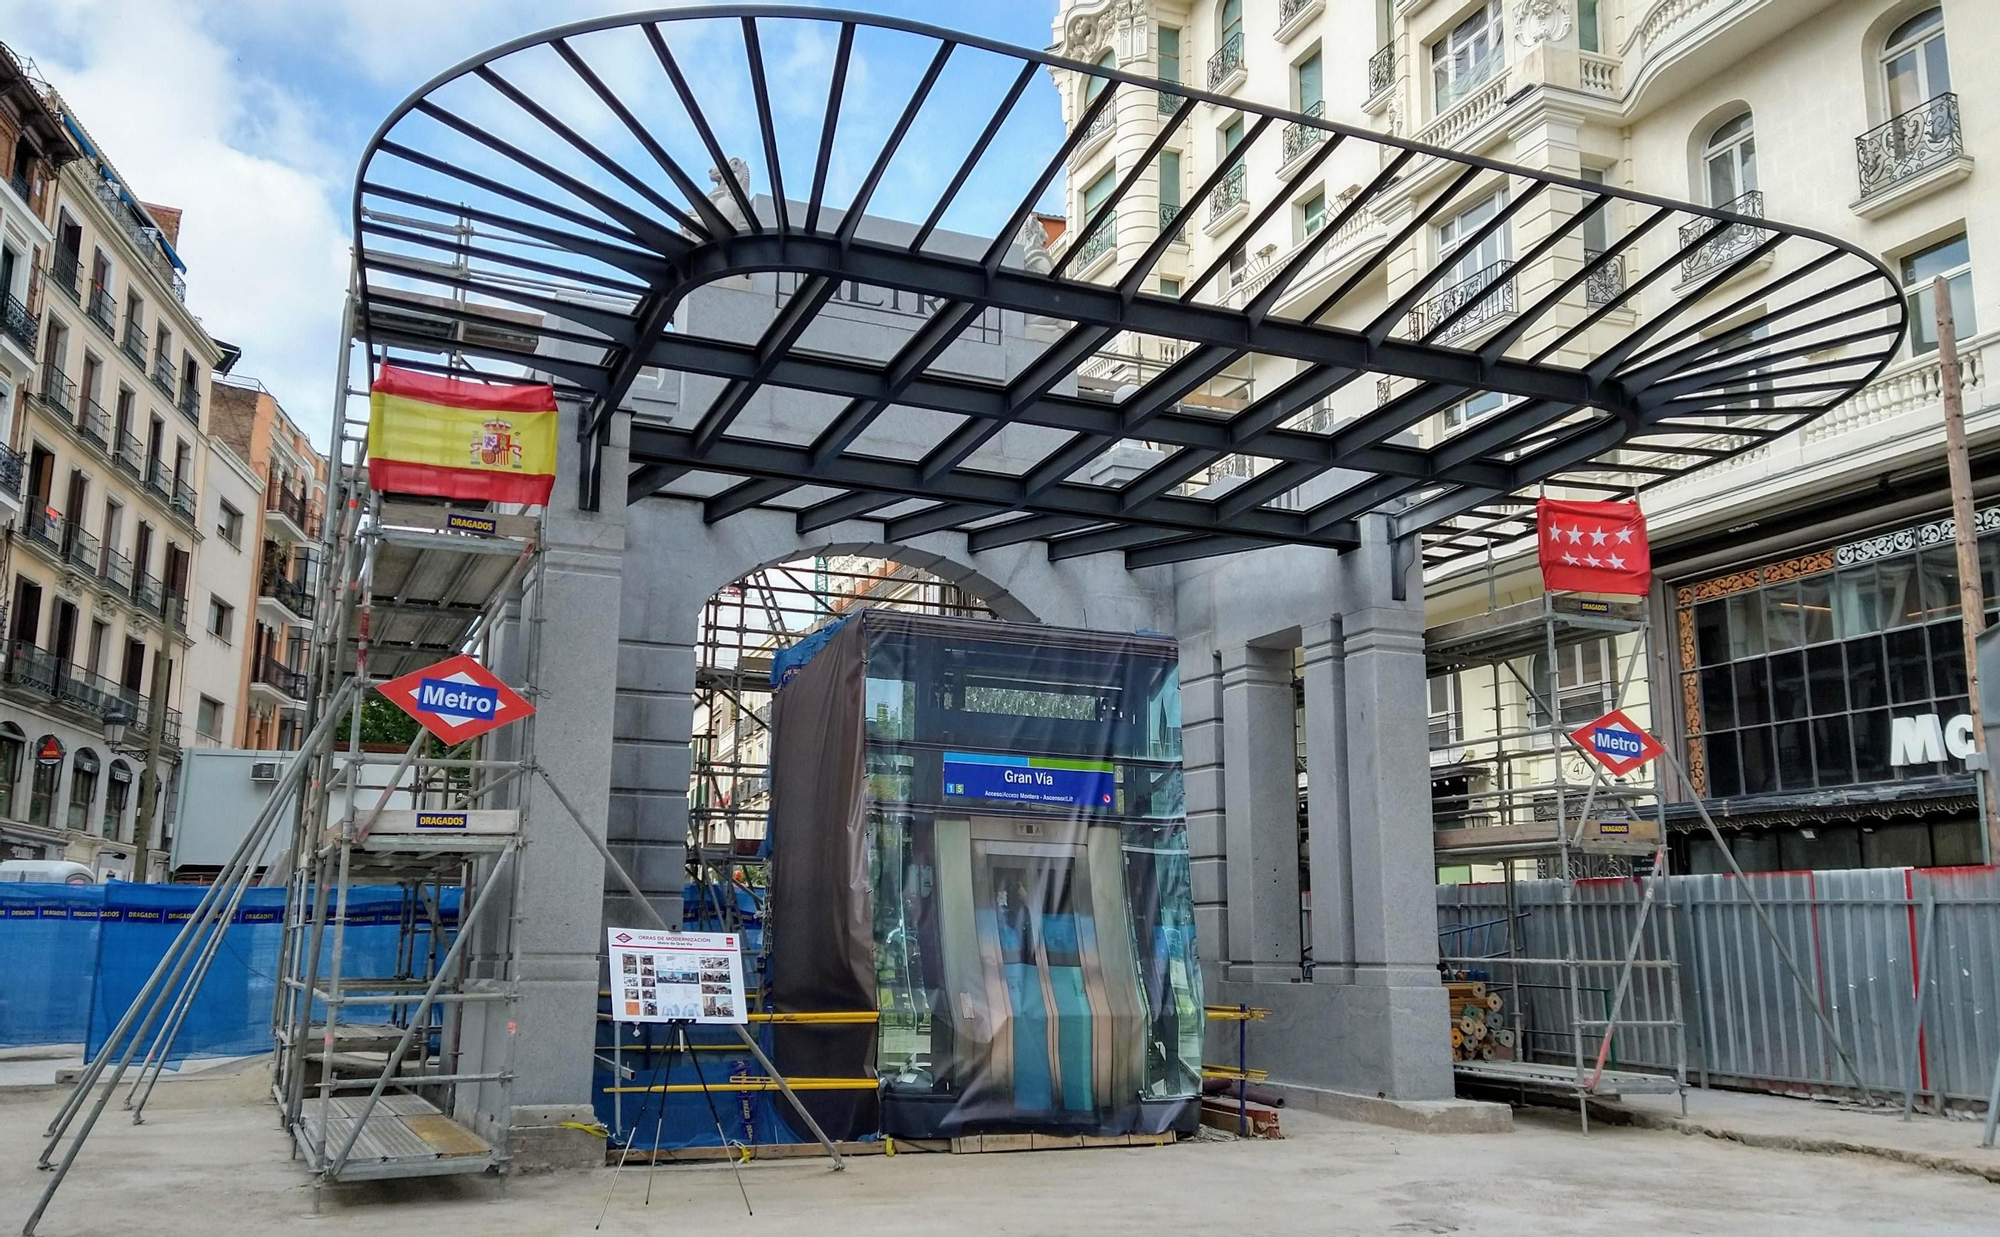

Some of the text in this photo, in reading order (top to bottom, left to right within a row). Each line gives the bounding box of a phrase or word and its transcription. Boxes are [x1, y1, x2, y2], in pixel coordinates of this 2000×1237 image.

[451, 518, 492, 530] DRAGADOS
[1582, 603, 1607, 611] DRAGADOS
[423, 685, 491, 713] Metro
[1597, 733, 1639, 753] Metro
[1573, 762, 1586, 775] 47
[1004, 770, 1053, 786] Gran Vía
[420, 816, 464, 826] DRAGADOS
[100, 910, 120, 918] GADOS
[128, 911, 160, 919] DRAGADOS
